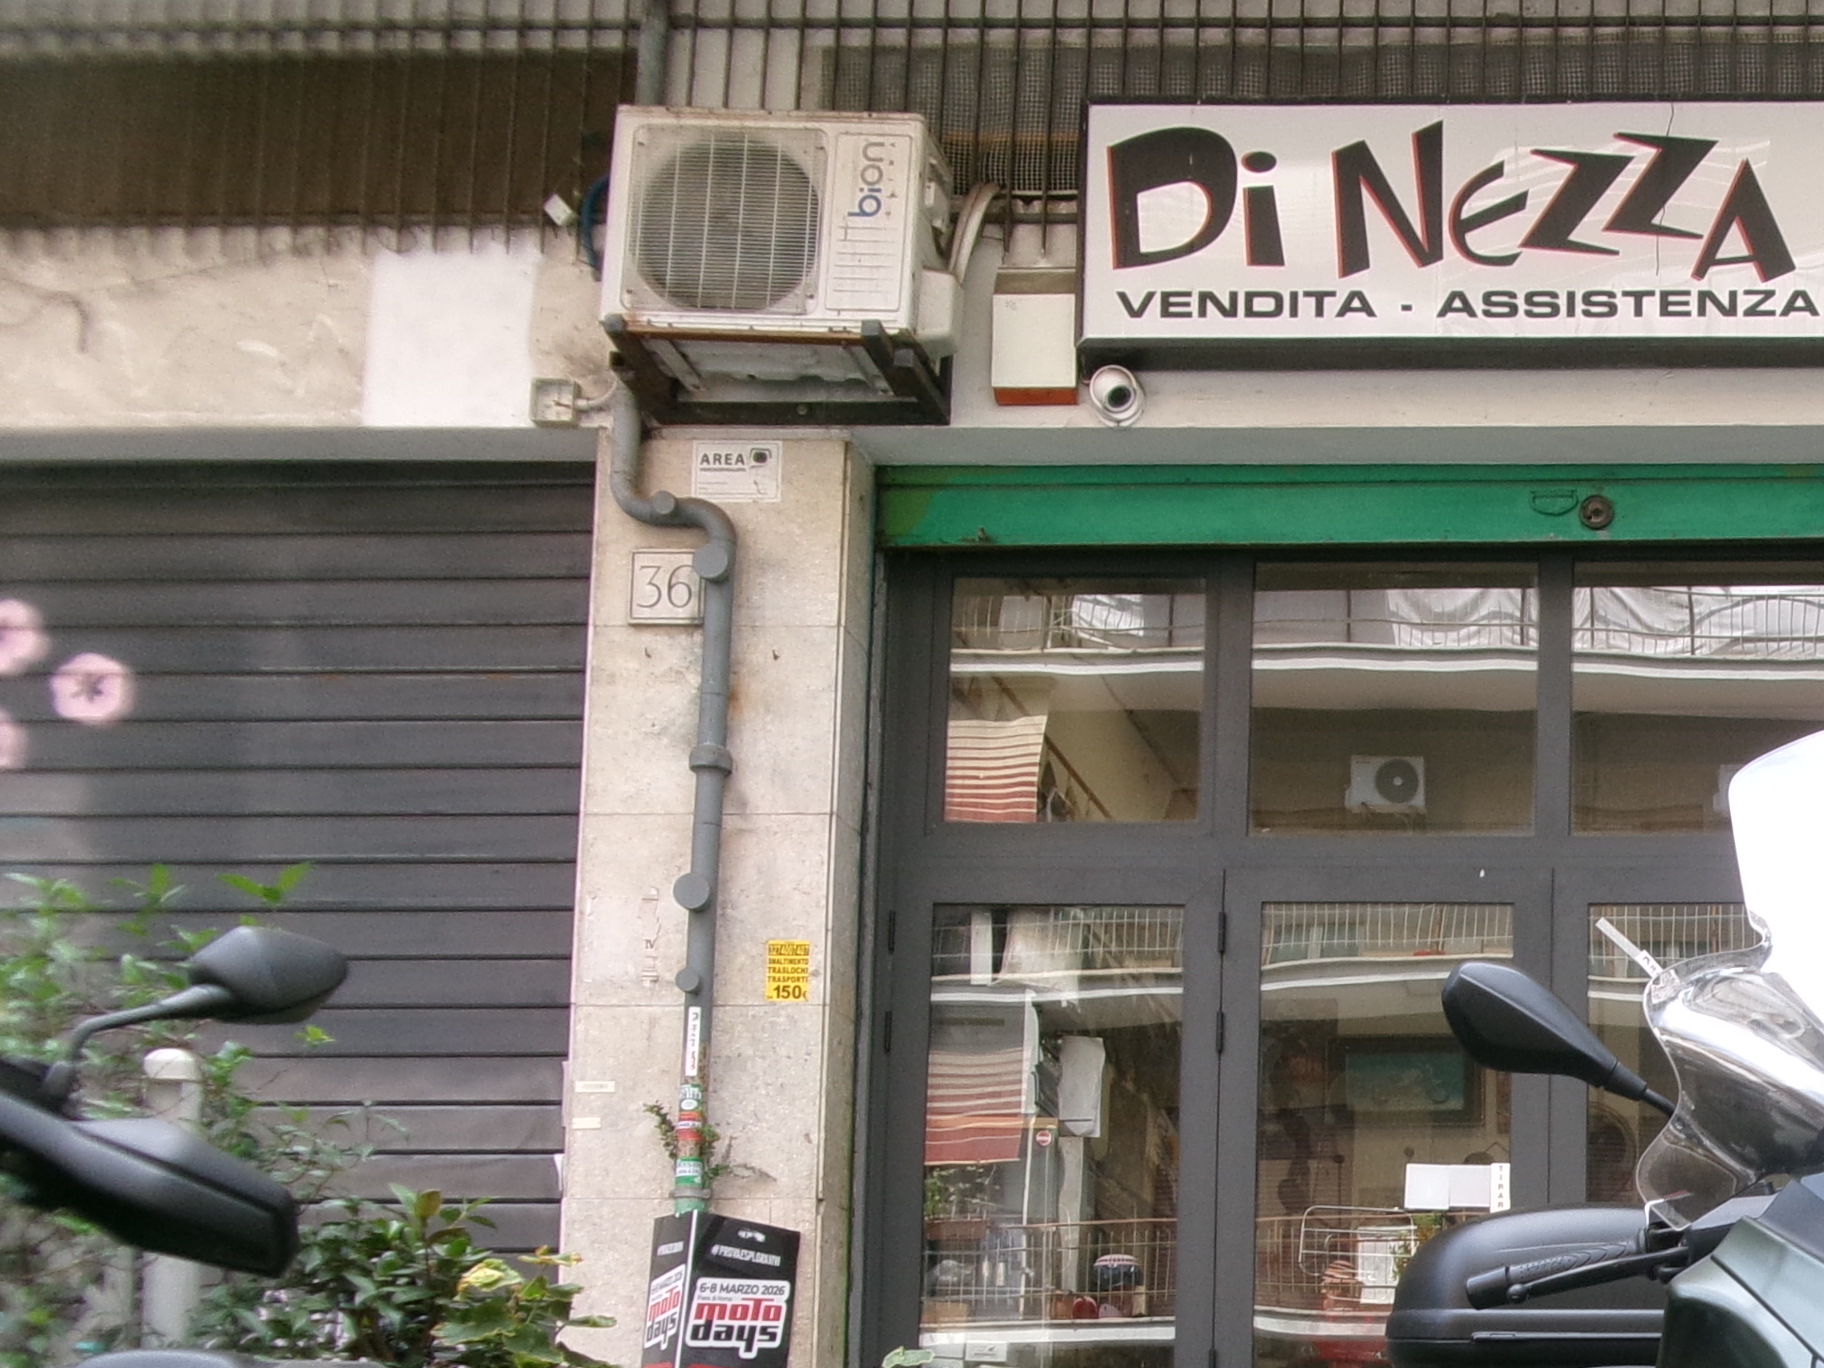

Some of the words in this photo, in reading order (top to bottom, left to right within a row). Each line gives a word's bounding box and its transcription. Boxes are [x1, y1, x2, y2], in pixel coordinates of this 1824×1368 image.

[848, 140, 886, 218] bion
[1116, 290, 1376, 318] VENDITA
[1436, 290, 1820, 318] ASSISTENZA
[700, 453, 745, 465] AREA
[635, 564, 694, 608] 36
[699, 1283, 717, 1293] 6-8
[719, 1283, 759, 1295] MARZO
[761, 1285, 786, 1295] 2026
[690, 1319, 779, 1353] days
